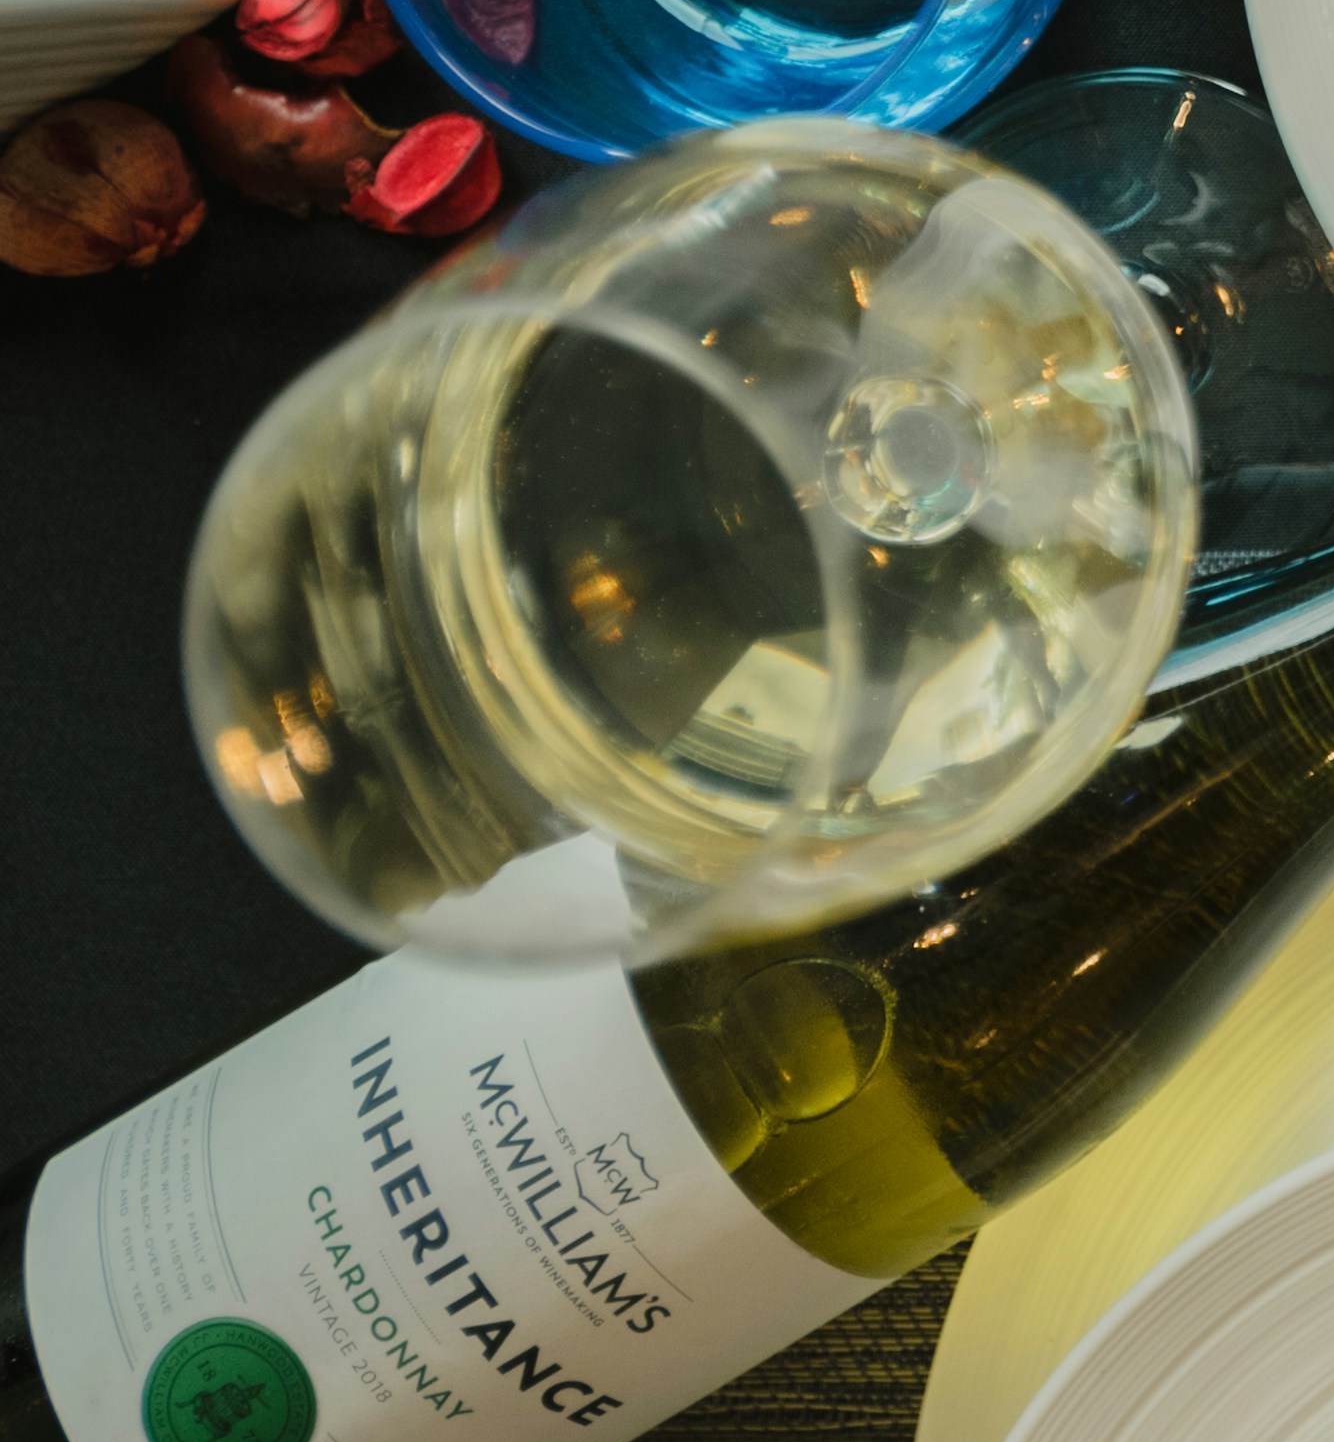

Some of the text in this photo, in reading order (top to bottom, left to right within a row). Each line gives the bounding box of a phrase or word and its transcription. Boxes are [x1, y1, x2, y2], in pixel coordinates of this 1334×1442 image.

[181, 1137, 191, 1146] A
[139, 1147, 152, 1192] DATES
[180, 1152, 193, 1204] PROUD
[119, 1188, 130, 1218] AND
[140, 1193, 152, 1232] BACK
[160, 1178, 172, 1216] WITH
[164, 1222, 175, 1233] A
[187, 1212, 206, 1263] FAMILY
[351, 1036, 623, 1426] INHERITANCE
[462, 1112, 605, 1327] SIX GENERATIONS OF WINEMAKING
[610, 1218, 636, 1243] 1877
[122, 1226, 136, 1272] FORTY
[146, 1237, 160, 1277] OVER
[169, 1238, 193, 1301] HISTORY
[156, 1282, 173, 1314] ONE
[202, 1273, 216, 1292] OF
[308, 1185, 474, 1419] CHARDONNAY
[132, 1283, 153, 1333] YEARS
[299, 1263, 392, 1403] VINTAGE 2018
[196, 1360, 217, 1382] 18
